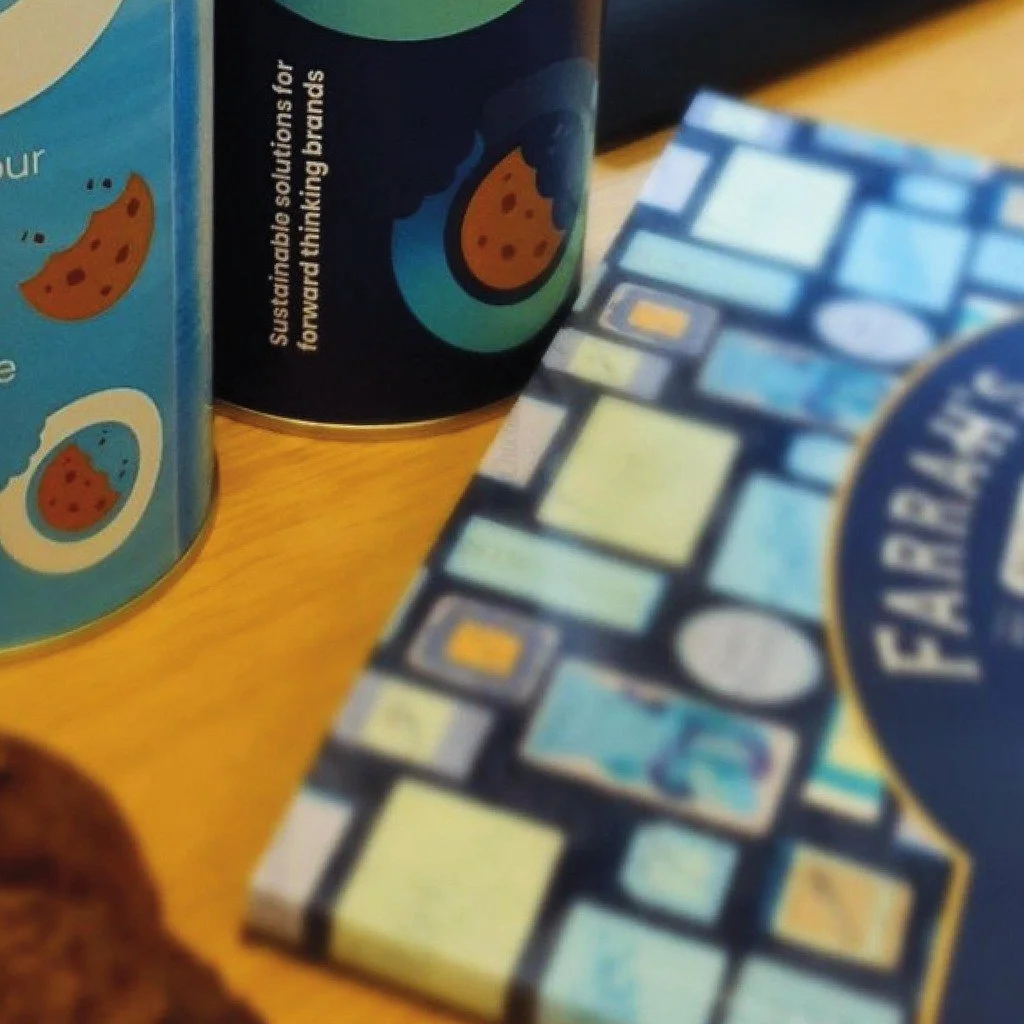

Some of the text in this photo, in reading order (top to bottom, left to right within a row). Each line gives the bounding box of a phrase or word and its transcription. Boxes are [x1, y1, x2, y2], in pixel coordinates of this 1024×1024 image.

[268, 58, 294, 347] Sustainable solutions for
[296, 69, 329, 352] forward thinking brands
